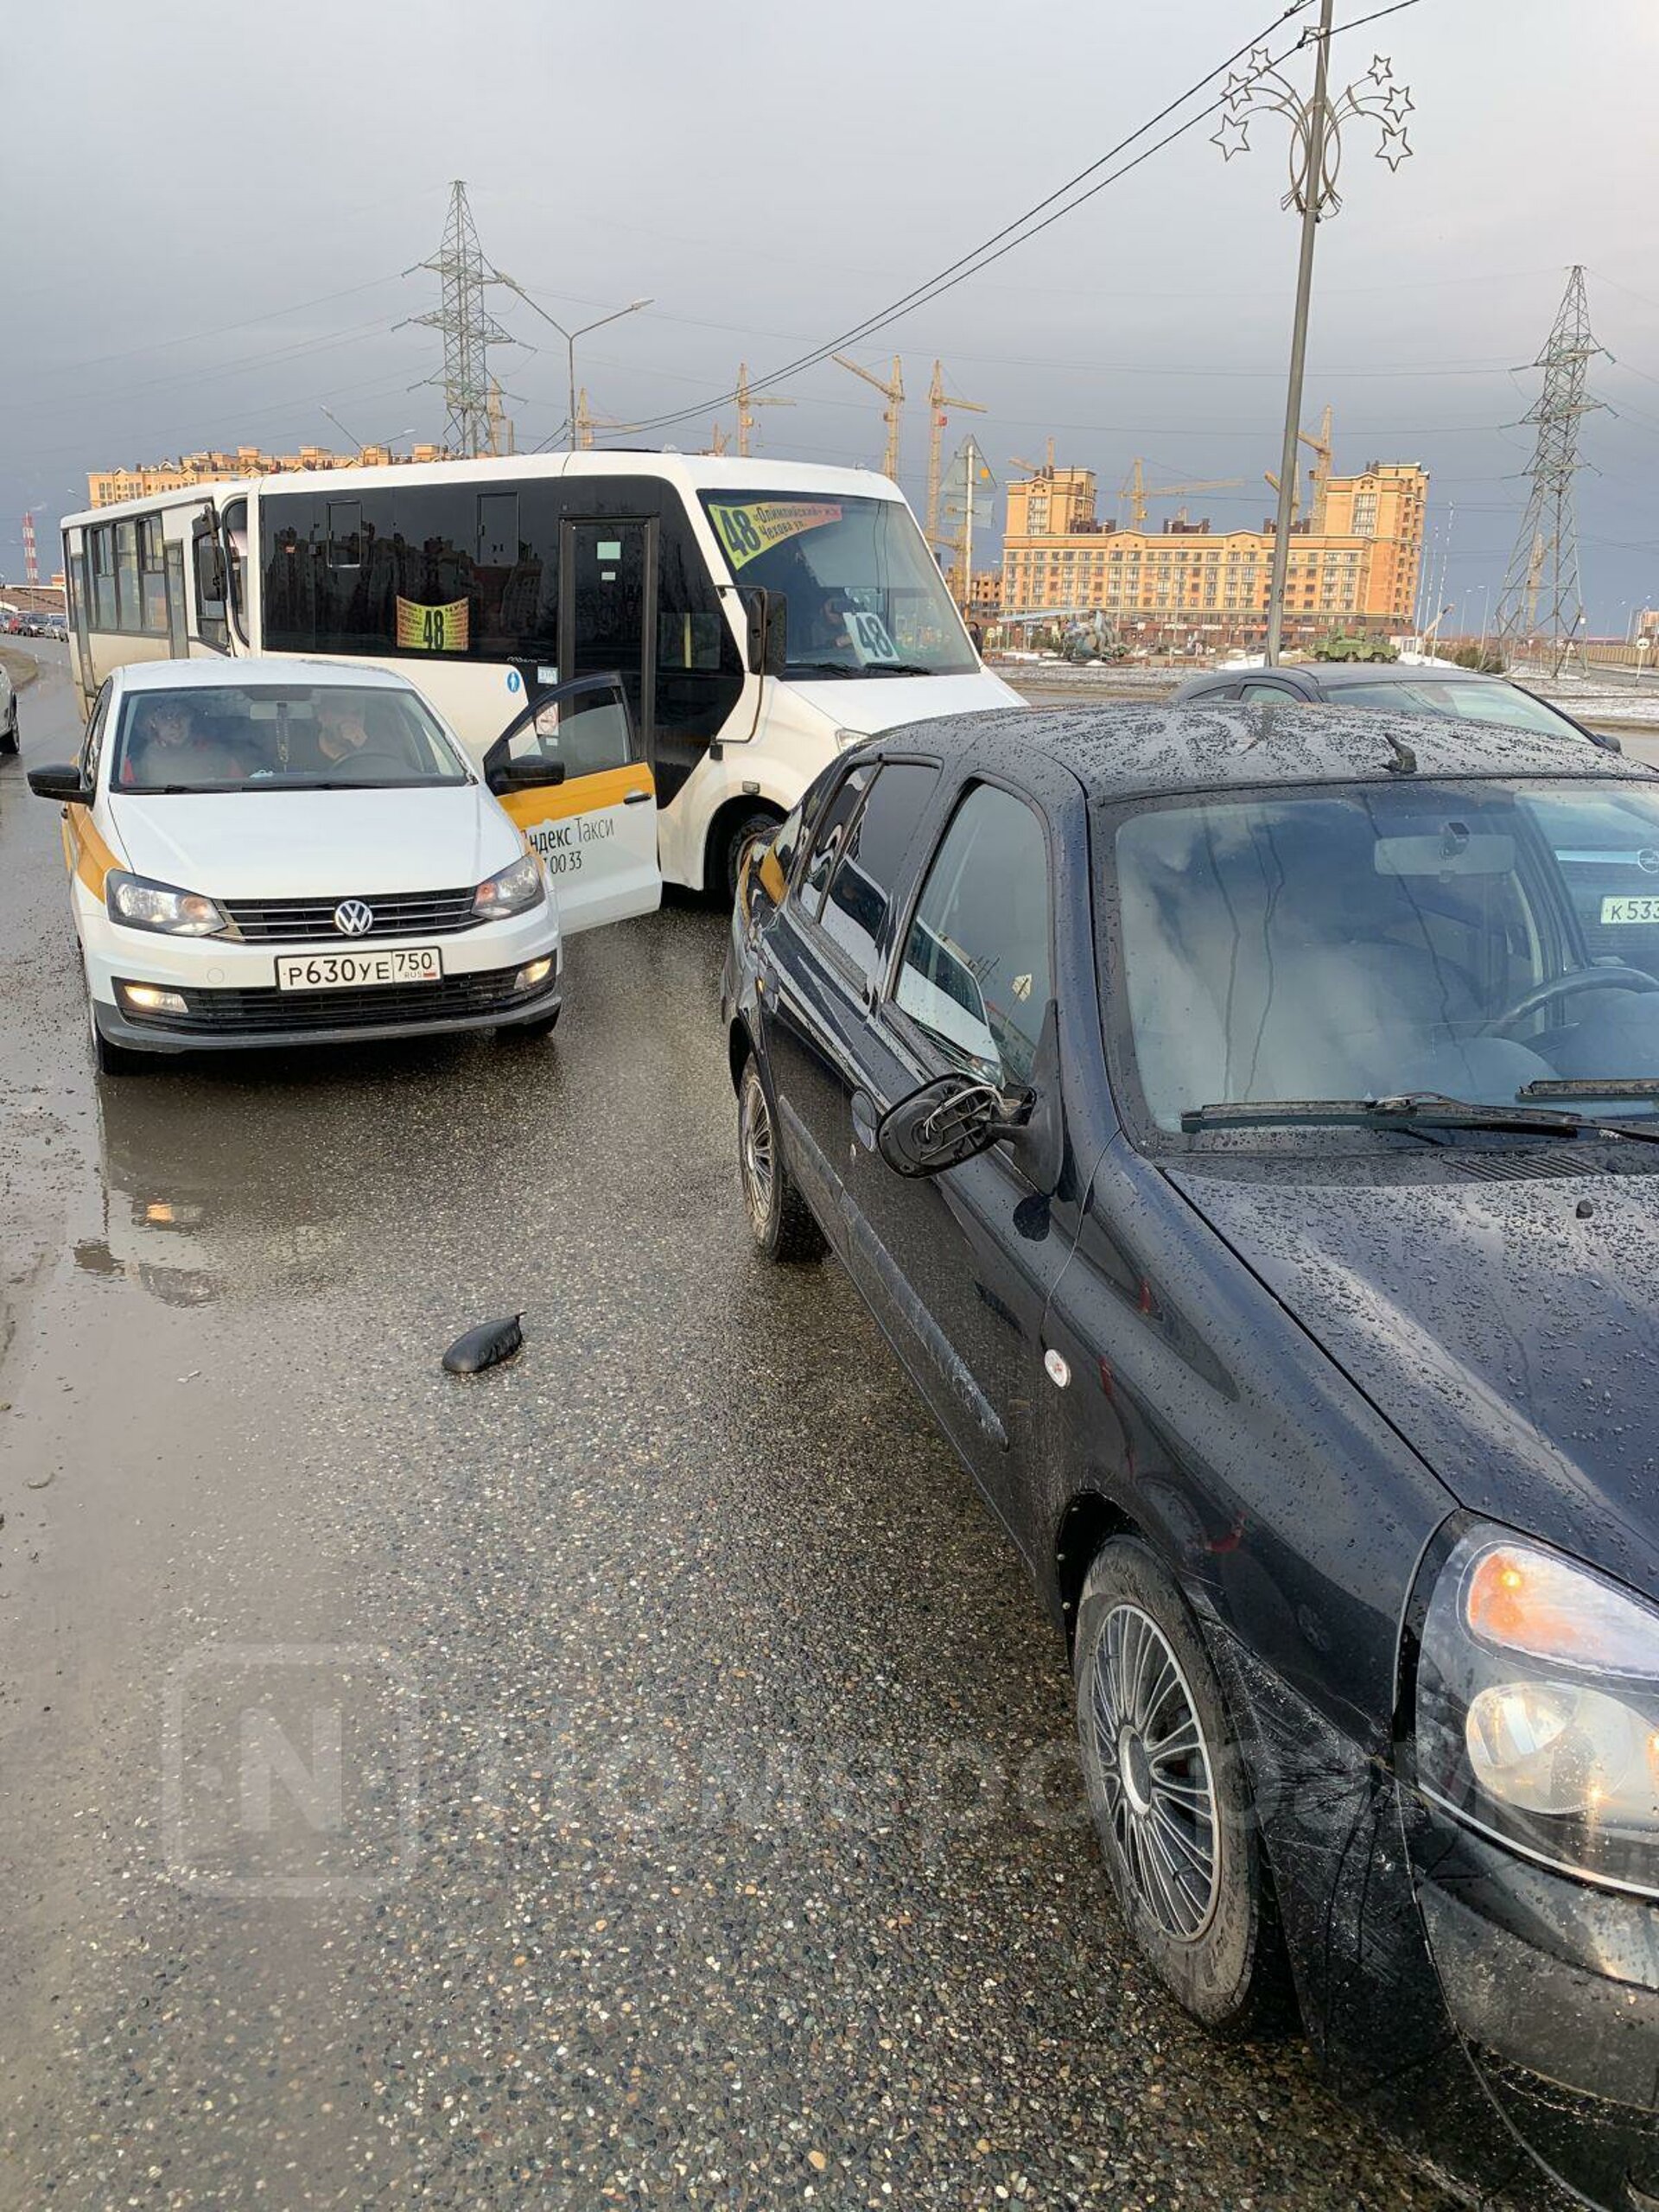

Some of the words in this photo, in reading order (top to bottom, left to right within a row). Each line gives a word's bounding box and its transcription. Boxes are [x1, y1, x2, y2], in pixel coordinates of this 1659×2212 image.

[719, 509, 761, 556] 48
[423, 610, 444, 650] 48
[855, 616, 893, 658] 48
[575, 817, 614, 842] Такси
[395, 952, 432, 972] 750
